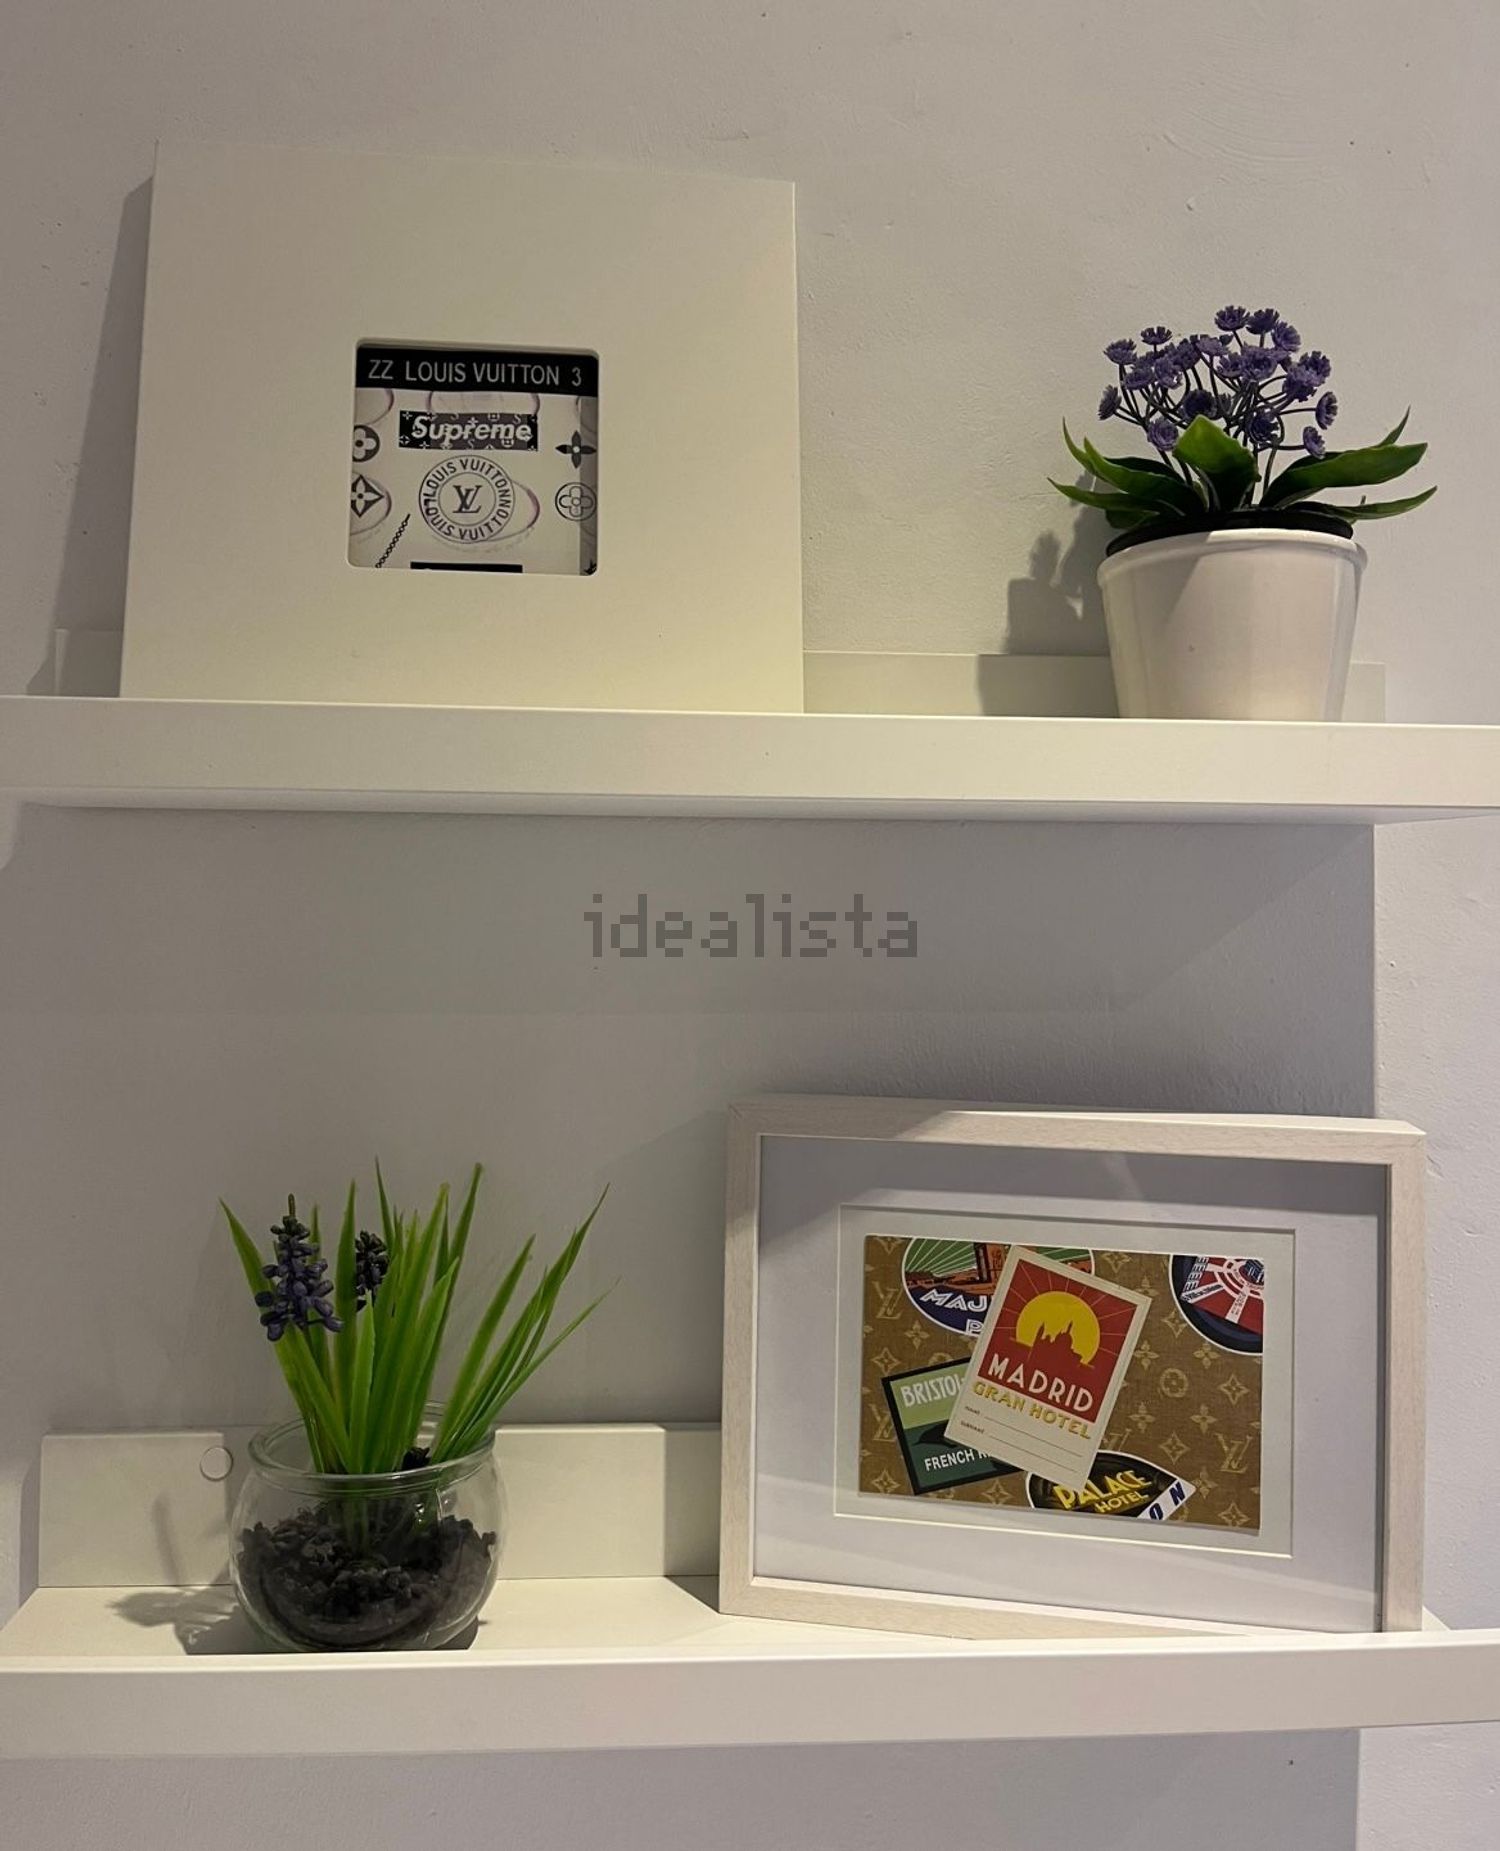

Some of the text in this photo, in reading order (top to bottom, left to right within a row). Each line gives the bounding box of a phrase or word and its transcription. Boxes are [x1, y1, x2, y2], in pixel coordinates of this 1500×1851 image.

[368, 359, 582, 387] ZZ LOUIS VUITTON 3
[411, 415, 533, 446] Supreme
[423, 458, 511, 498] LOUIS VUITTON
[423, 499, 511, 541] LOUIS VUITTON
[920, 1288, 992, 1312] MAJ
[987, 1353, 1094, 1413] MADRID
[972, 1381, 1026, 1413] GRAN
[1029, 1402, 1092, 1440] HOTEL
[924, 1448, 975, 1472] FRENCH
[1053, 1470, 1152, 1510] PALACE
[1094, 1490, 1149, 1513] HOTEL
